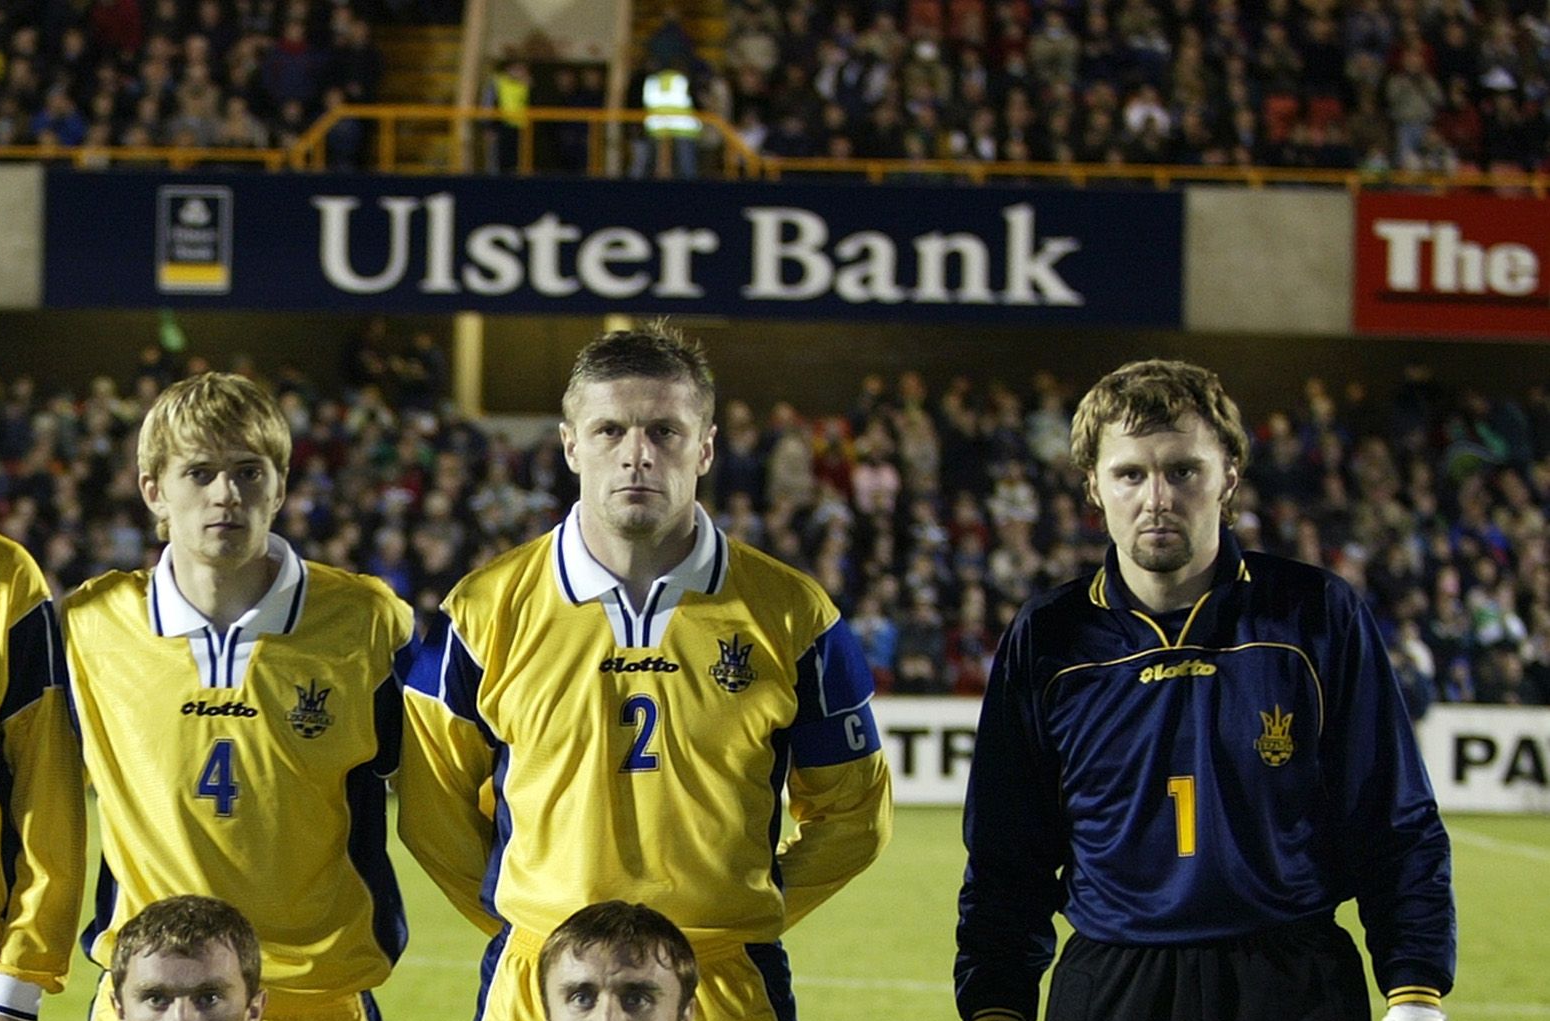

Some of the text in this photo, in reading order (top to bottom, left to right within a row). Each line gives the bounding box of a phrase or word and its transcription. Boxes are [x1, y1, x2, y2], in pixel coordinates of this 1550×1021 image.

[313, 192, 1084, 306] Ulster Bank
[1372, 218, 1540, 296] The
[616, 657, 680, 674] lotto
[1155, 659, 1217, 681] lotto
[197, 701, 258, 717] lotto
[618, 693, 661, 773] 2
[844, 713, 866, 750] C
[195, 738, 239, 817] 4
[1167, 775, 1196, 857] 1
